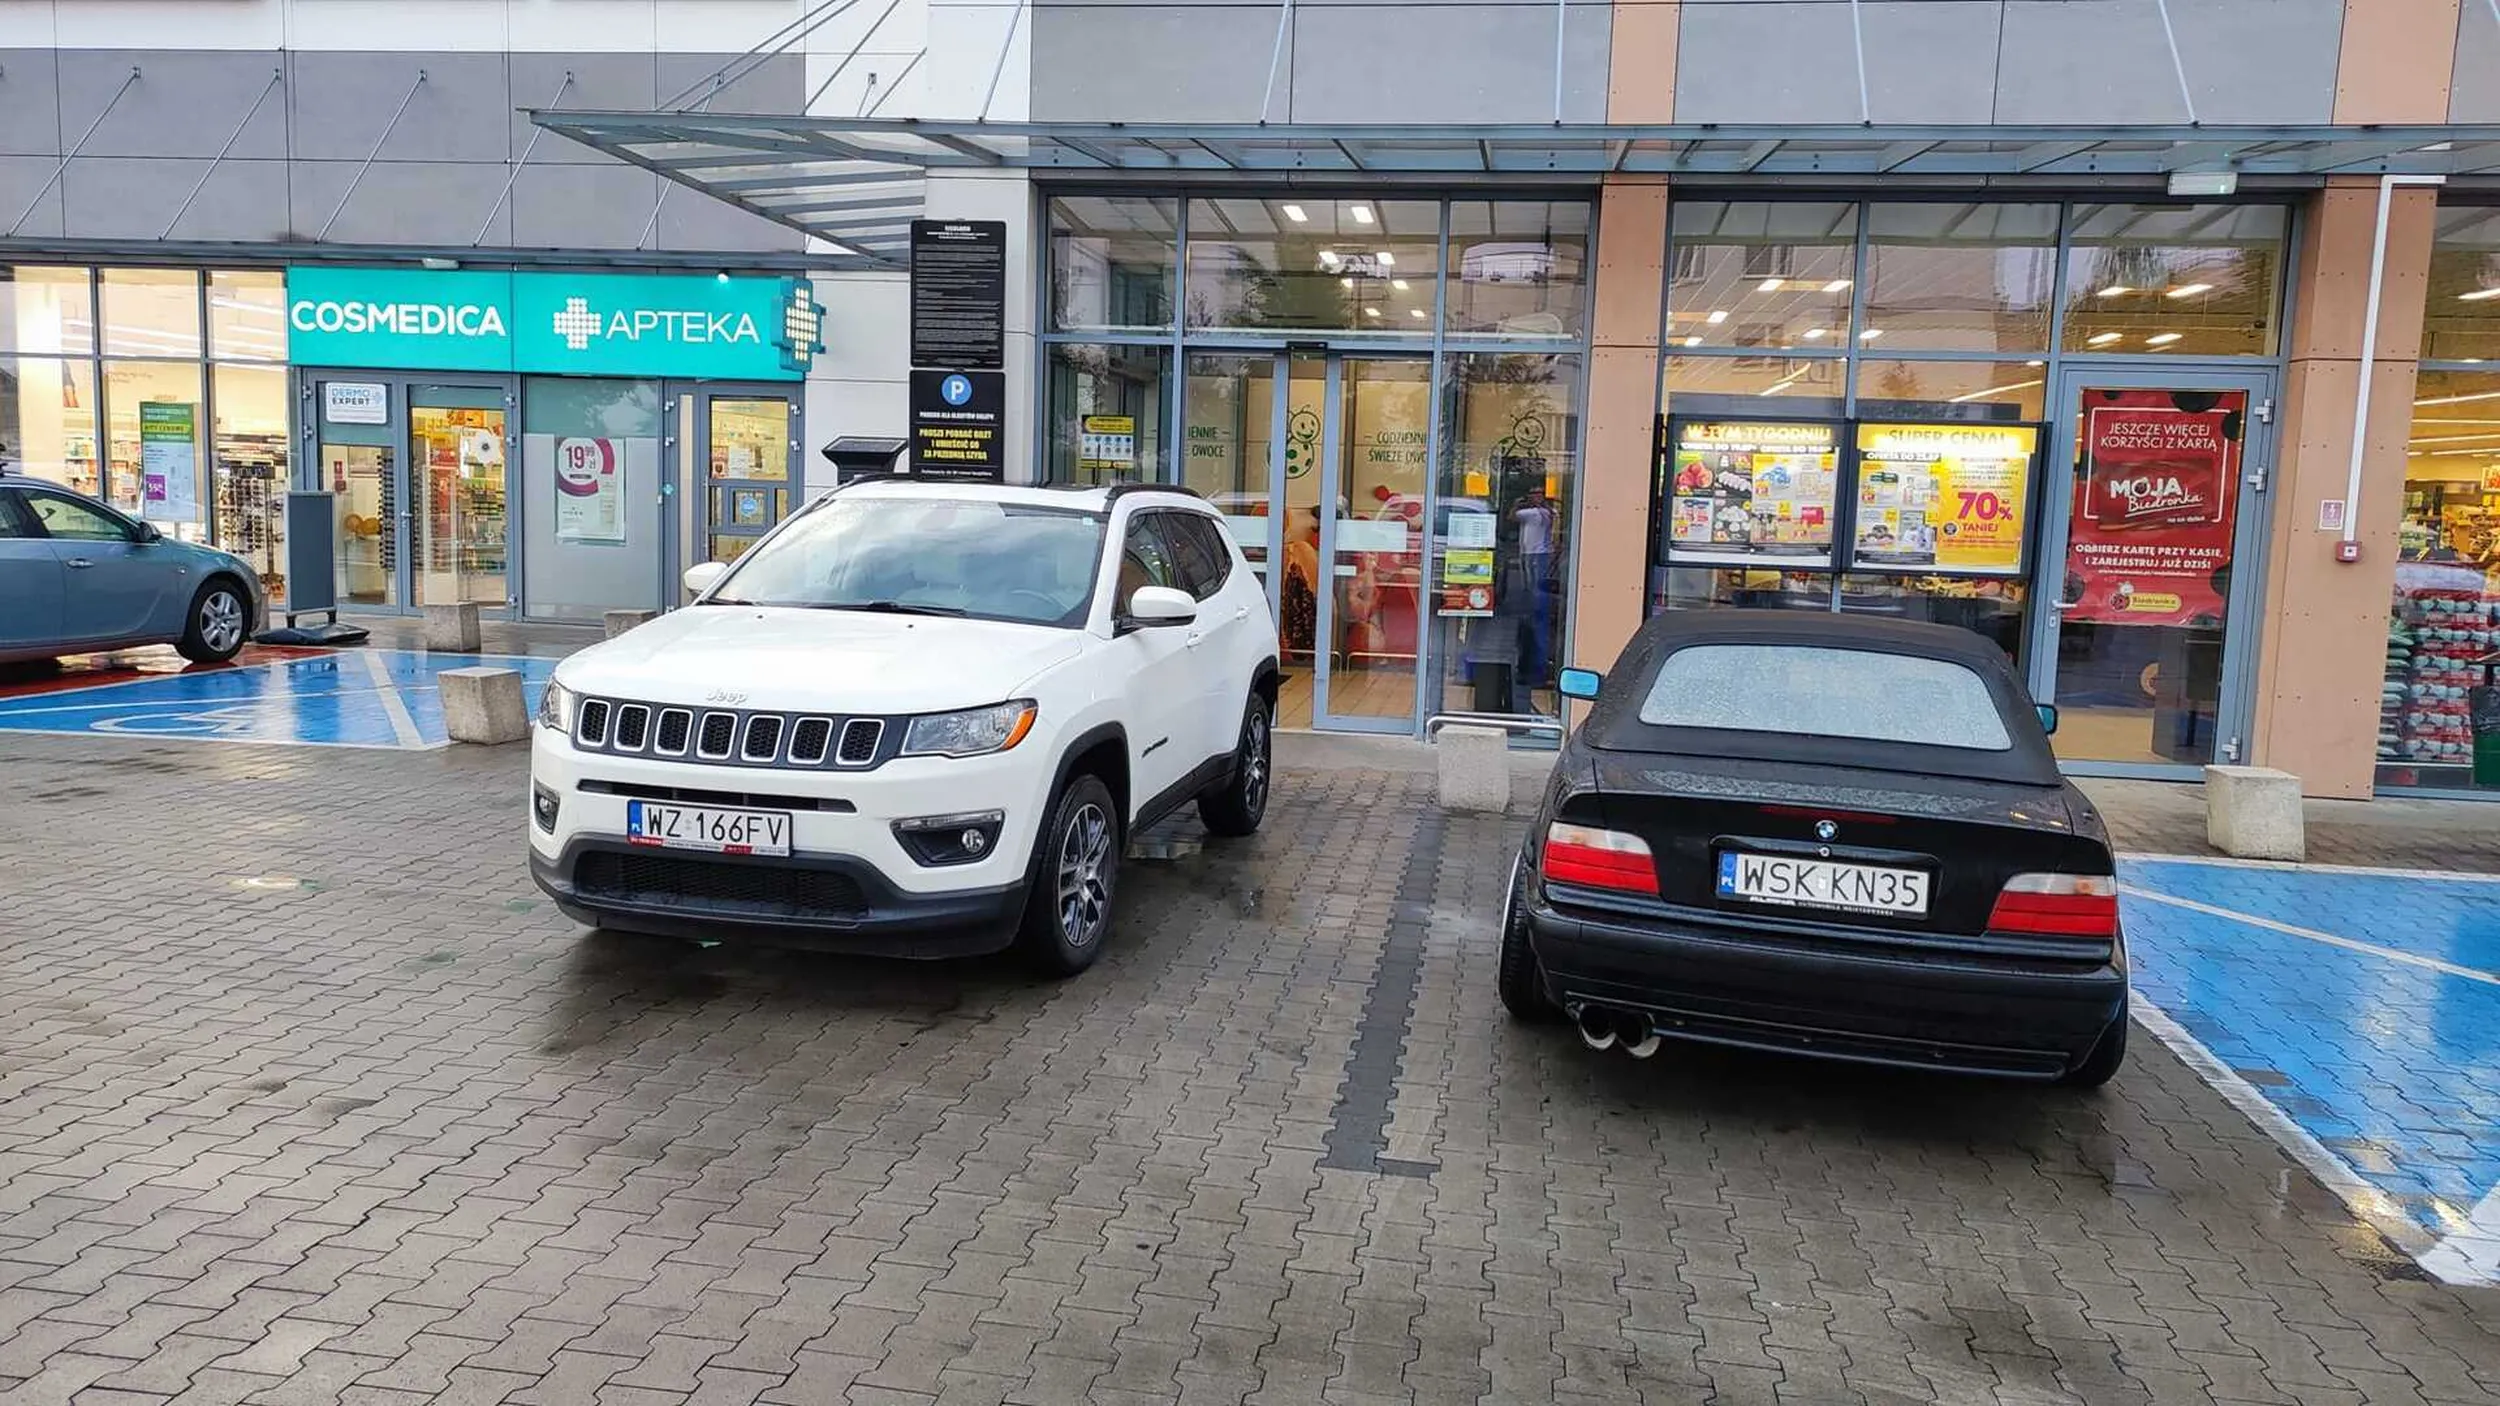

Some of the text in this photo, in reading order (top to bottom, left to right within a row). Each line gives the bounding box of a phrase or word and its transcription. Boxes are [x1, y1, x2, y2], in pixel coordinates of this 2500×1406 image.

[291, 301, 506, 337] COSMEDICA
[605, 309, 760, 343] APTEKA
[332, 388, 371, 397] DERMO
[951, 381, 965, 400] P
[332, 397, 371, 405] EXPERT
[1745, 426, 1832, 441] TYGODNIU
[2109, 422, 2210, 438] JESZCZE WIĘCEJ
[1191, 445, 1225, 458] OWOCE
[2100, 435, 2217, 452] KORZYŚCI Z KARTĄ
[565, 446, 585, 469] 19
[2110, 477, 2183, 499] MOJA
[2128, 487, 2204, 512] Biedronka
[1962, 523, 1999, 532] TANIEJ
[2075, 544, 2121, 554] ODBIERZ
[2122, 545, 2156, 556] KARTĘ
[2157, 546, 2186, 556] PRZY
[2091, 557, 2159, 568] ZAREJESTRUJ
[2161, 557, 2181, 568] JUŻ
[2183, 558, 2211, 569] DZIŚ!
[705, 687, 748, 706] Jeep
[648, 808, 783, 845] WZ 166FV
[1721, 876, 1734, 888] PL
[1744, 859, 1919, 907] WSK KN35
